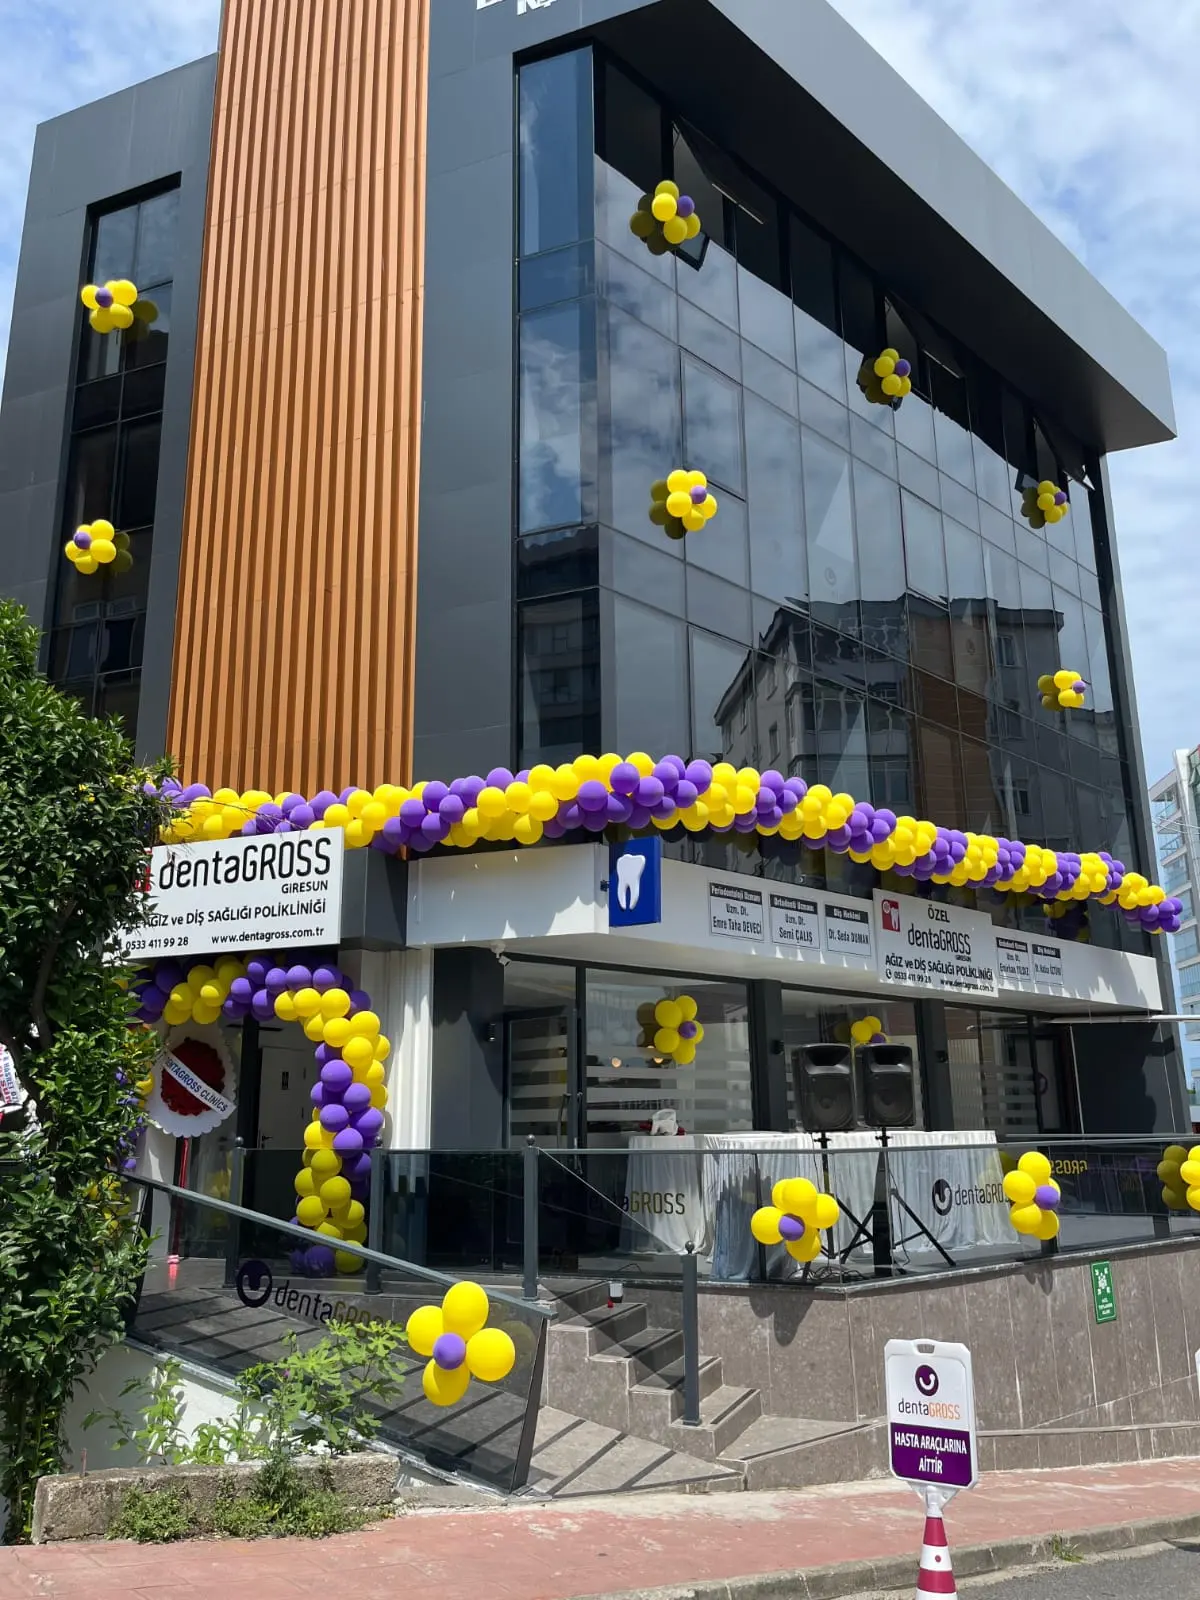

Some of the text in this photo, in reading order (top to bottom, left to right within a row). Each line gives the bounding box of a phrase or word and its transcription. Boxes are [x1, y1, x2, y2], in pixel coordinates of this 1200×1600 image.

[158, 836, 332, 890] dentaGROSS
[171, 917, 184, 925] ve
[186, 908, 205, 926] DİŞ
[208, 905, 252, 922] SAĞLIĞI
[254, 898, 326, 919] POLİKLİNİĞİ
[927, 904, 950, 923] ÖZEL
[713, 916, 727, 929] Emre
[728, 918, 741, 931] Taha
[125, 936, 189, 951] 0533 411 99 28
[211, 927, 324, 944] www.dentagross.com.tr
[907, 922, 971, 955] dentaGROSS
[885, 953, 903, 968] AĞIZ
[905, 960, 914, 969] ve
[914, 957, 927, 973] DİŞ
[200, 1089, 228, 1112] CLINICS
[898, 1398, 961, 1420] dentaGROSS
[894, 1431, 968, 1455] HASTA ARAÇLARINA
[918, 1455, 943, 1474] AİTTİR
